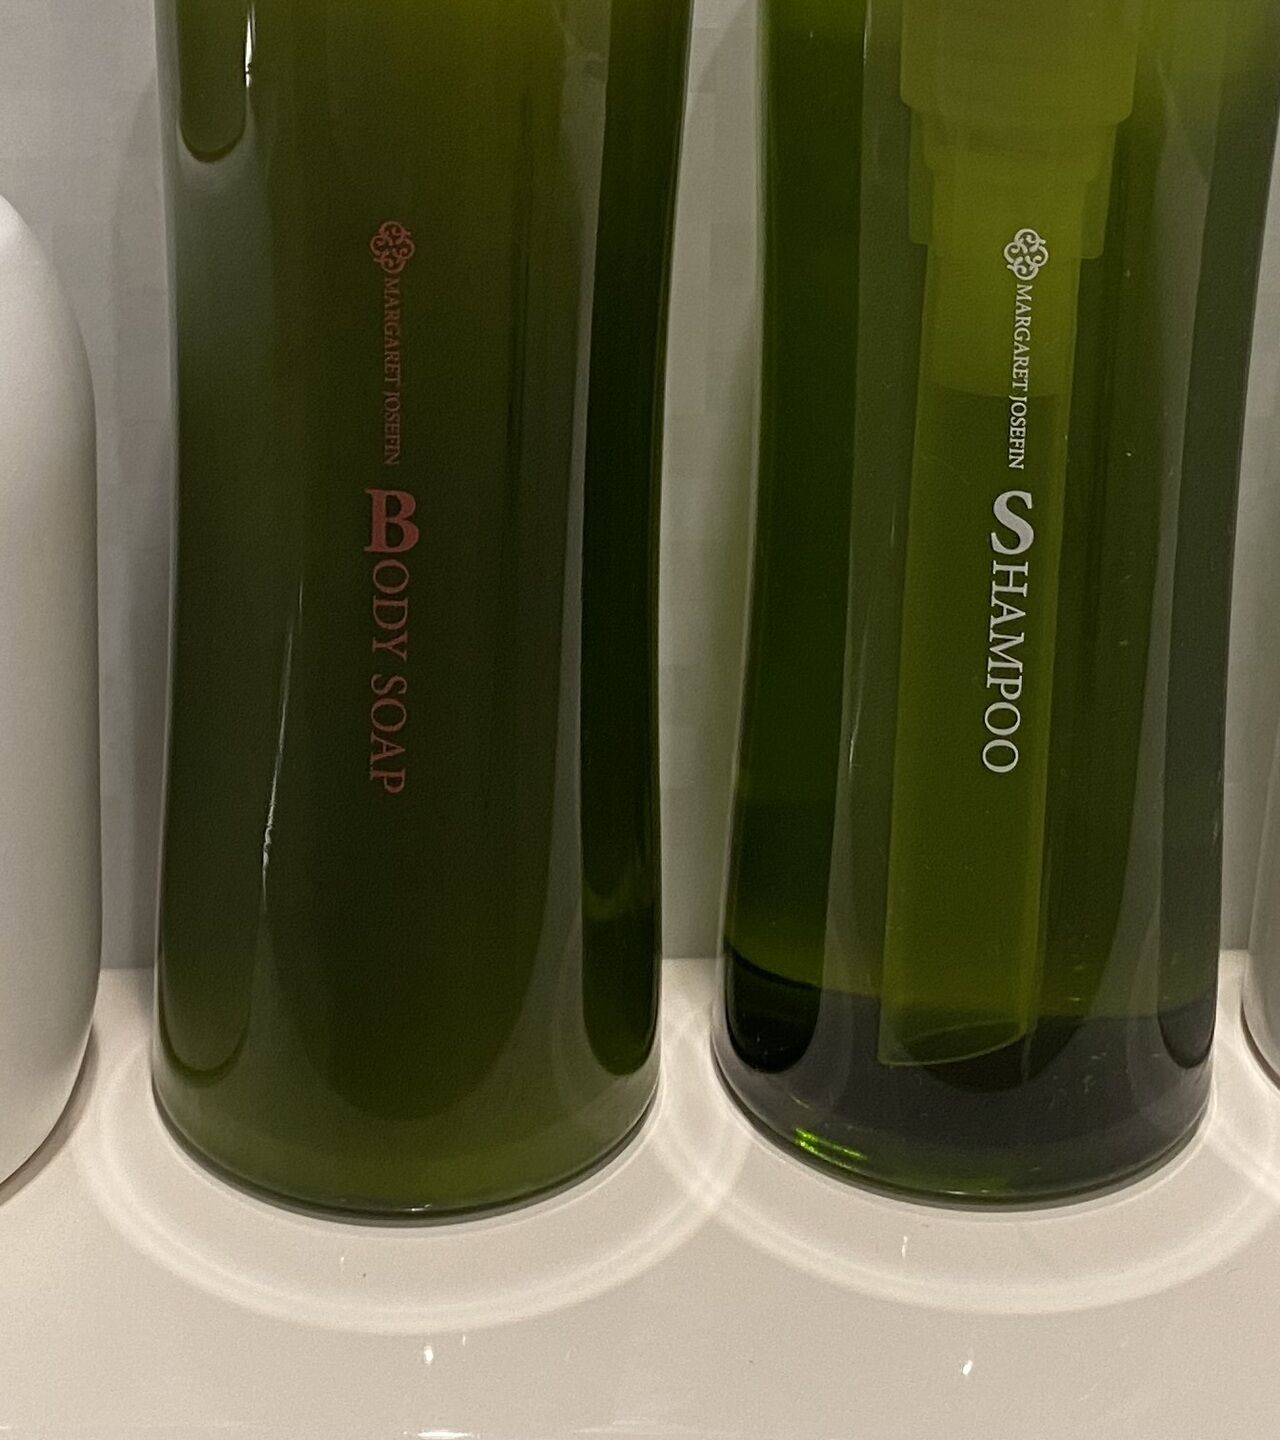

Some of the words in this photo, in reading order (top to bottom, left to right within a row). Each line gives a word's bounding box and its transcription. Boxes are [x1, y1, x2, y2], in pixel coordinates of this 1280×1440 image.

[383, 276, 402, 386] MARGARET
[1012, 284, 1032, 393] MARGARET
[382, 390, 401, 464] JOSEFIN
[1008, 396, 1028, 469] JOSEFIN
[364, 488, 419, 660] BODY
[982, 490, 1034, 773] SHAMPOO
[369, 674, 407, 794] SOAP
